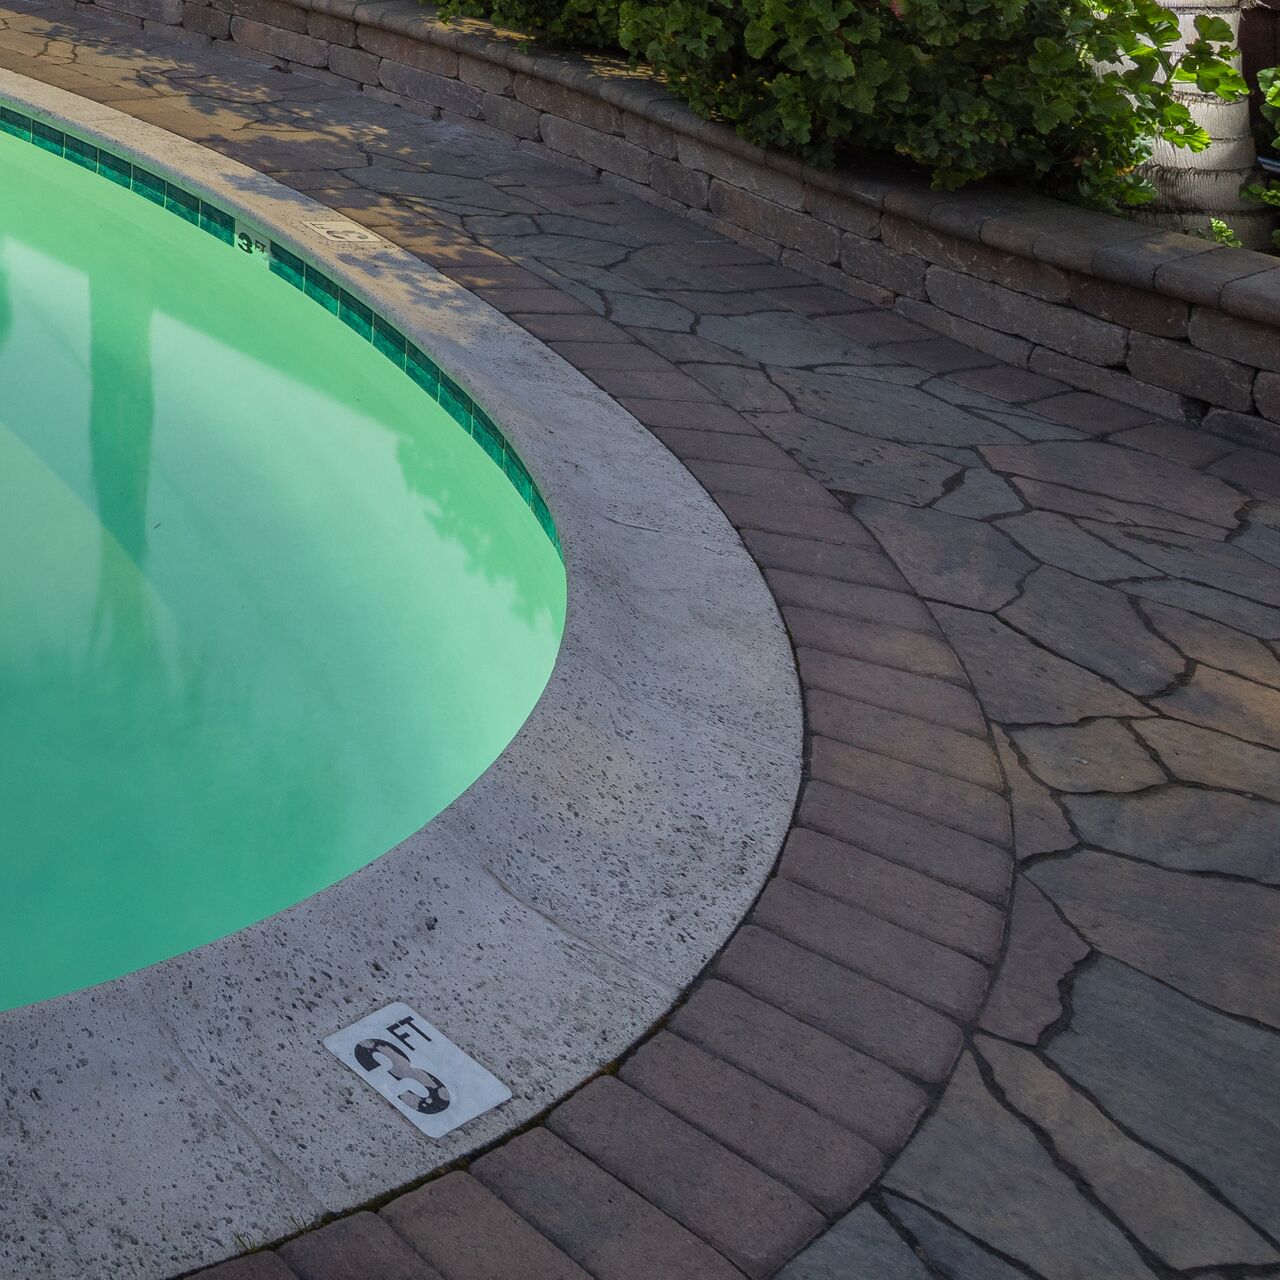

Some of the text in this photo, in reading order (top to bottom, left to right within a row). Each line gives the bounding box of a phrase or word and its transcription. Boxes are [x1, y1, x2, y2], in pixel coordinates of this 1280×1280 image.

[237, 232, 267, 254] 3 FT
[354, 1016, 451, 1115] 3 FT
